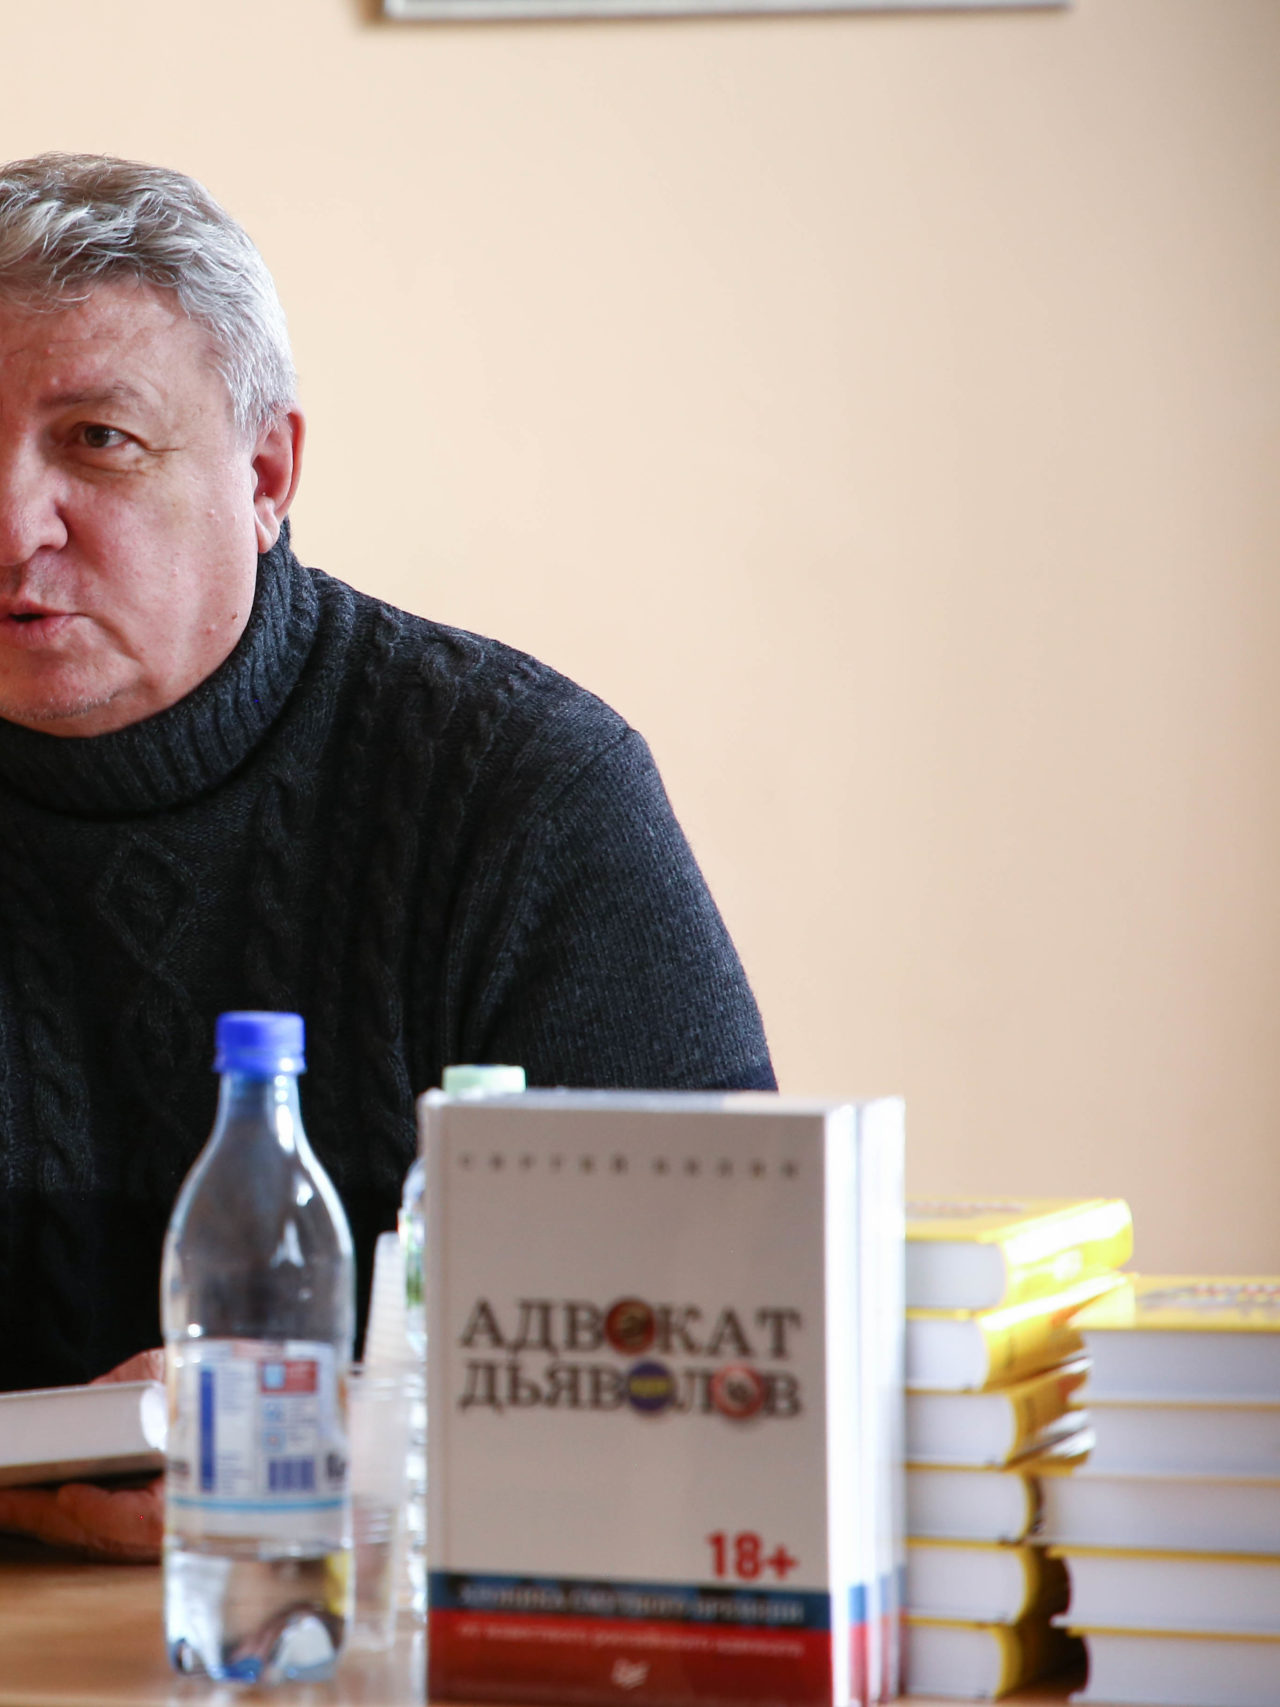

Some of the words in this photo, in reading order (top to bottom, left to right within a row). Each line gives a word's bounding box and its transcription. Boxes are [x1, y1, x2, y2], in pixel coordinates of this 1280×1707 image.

[460, 1295, 803, 1360] АДВОКАТ
[459, 1358, 803, 1421] ДЬЯВОЛОВ
[705, 1531, 799, 1582] 18+
